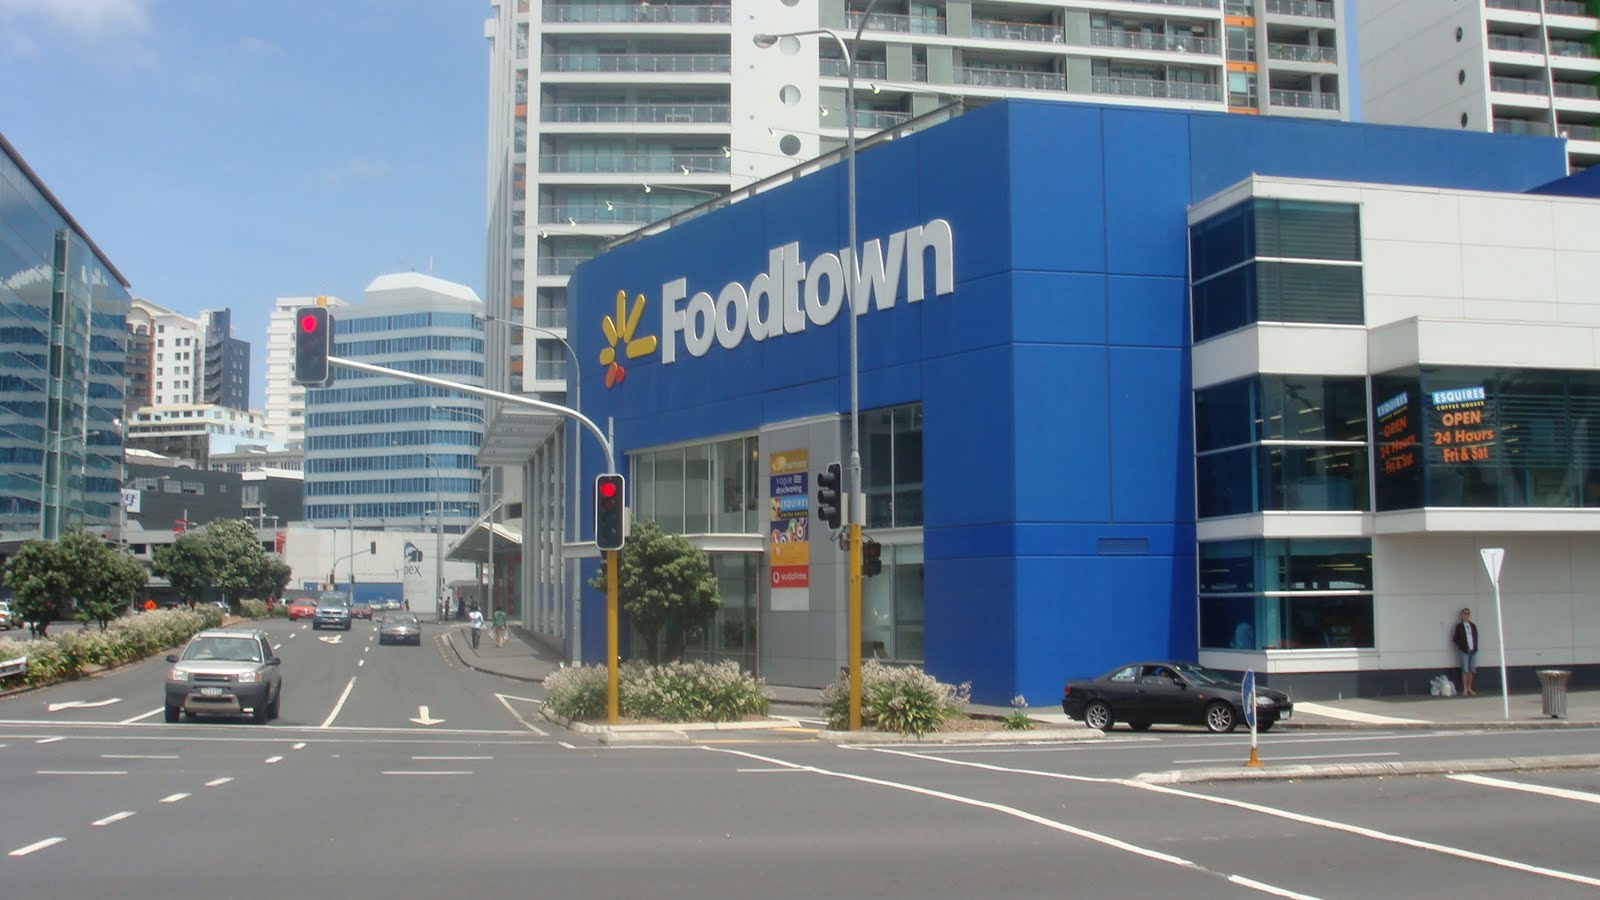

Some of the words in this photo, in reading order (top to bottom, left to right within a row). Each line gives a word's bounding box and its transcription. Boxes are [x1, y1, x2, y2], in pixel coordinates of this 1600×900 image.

[662, 218, 954, 365] Foodtown
[1434, 387, 1486, 403] ESQUIRES
[1377, 392, 1408, 417] ESQUIRES
[1441, 410, 1482, 427] OPEN
[1383, 415, 1407, 439] OPEN
[1434, 430, 1451, 445] 24
[1455, 429, 1494, 443] Hours
[1380, 444, 1390, 459] 24
[1391, 434, 1416, 453] Hours
[1443, 447, 1459, 463] Fri
[1460, 446, 1469, 461] &
[1471, 445, 1488, 460] Sat
[775, 476, 793, 487] Vogue
[775, 485, 802, 495] drycleaning
[781, 498, 808, 509] ESQUIRES
[781, 571, 807, 581] vodafone
